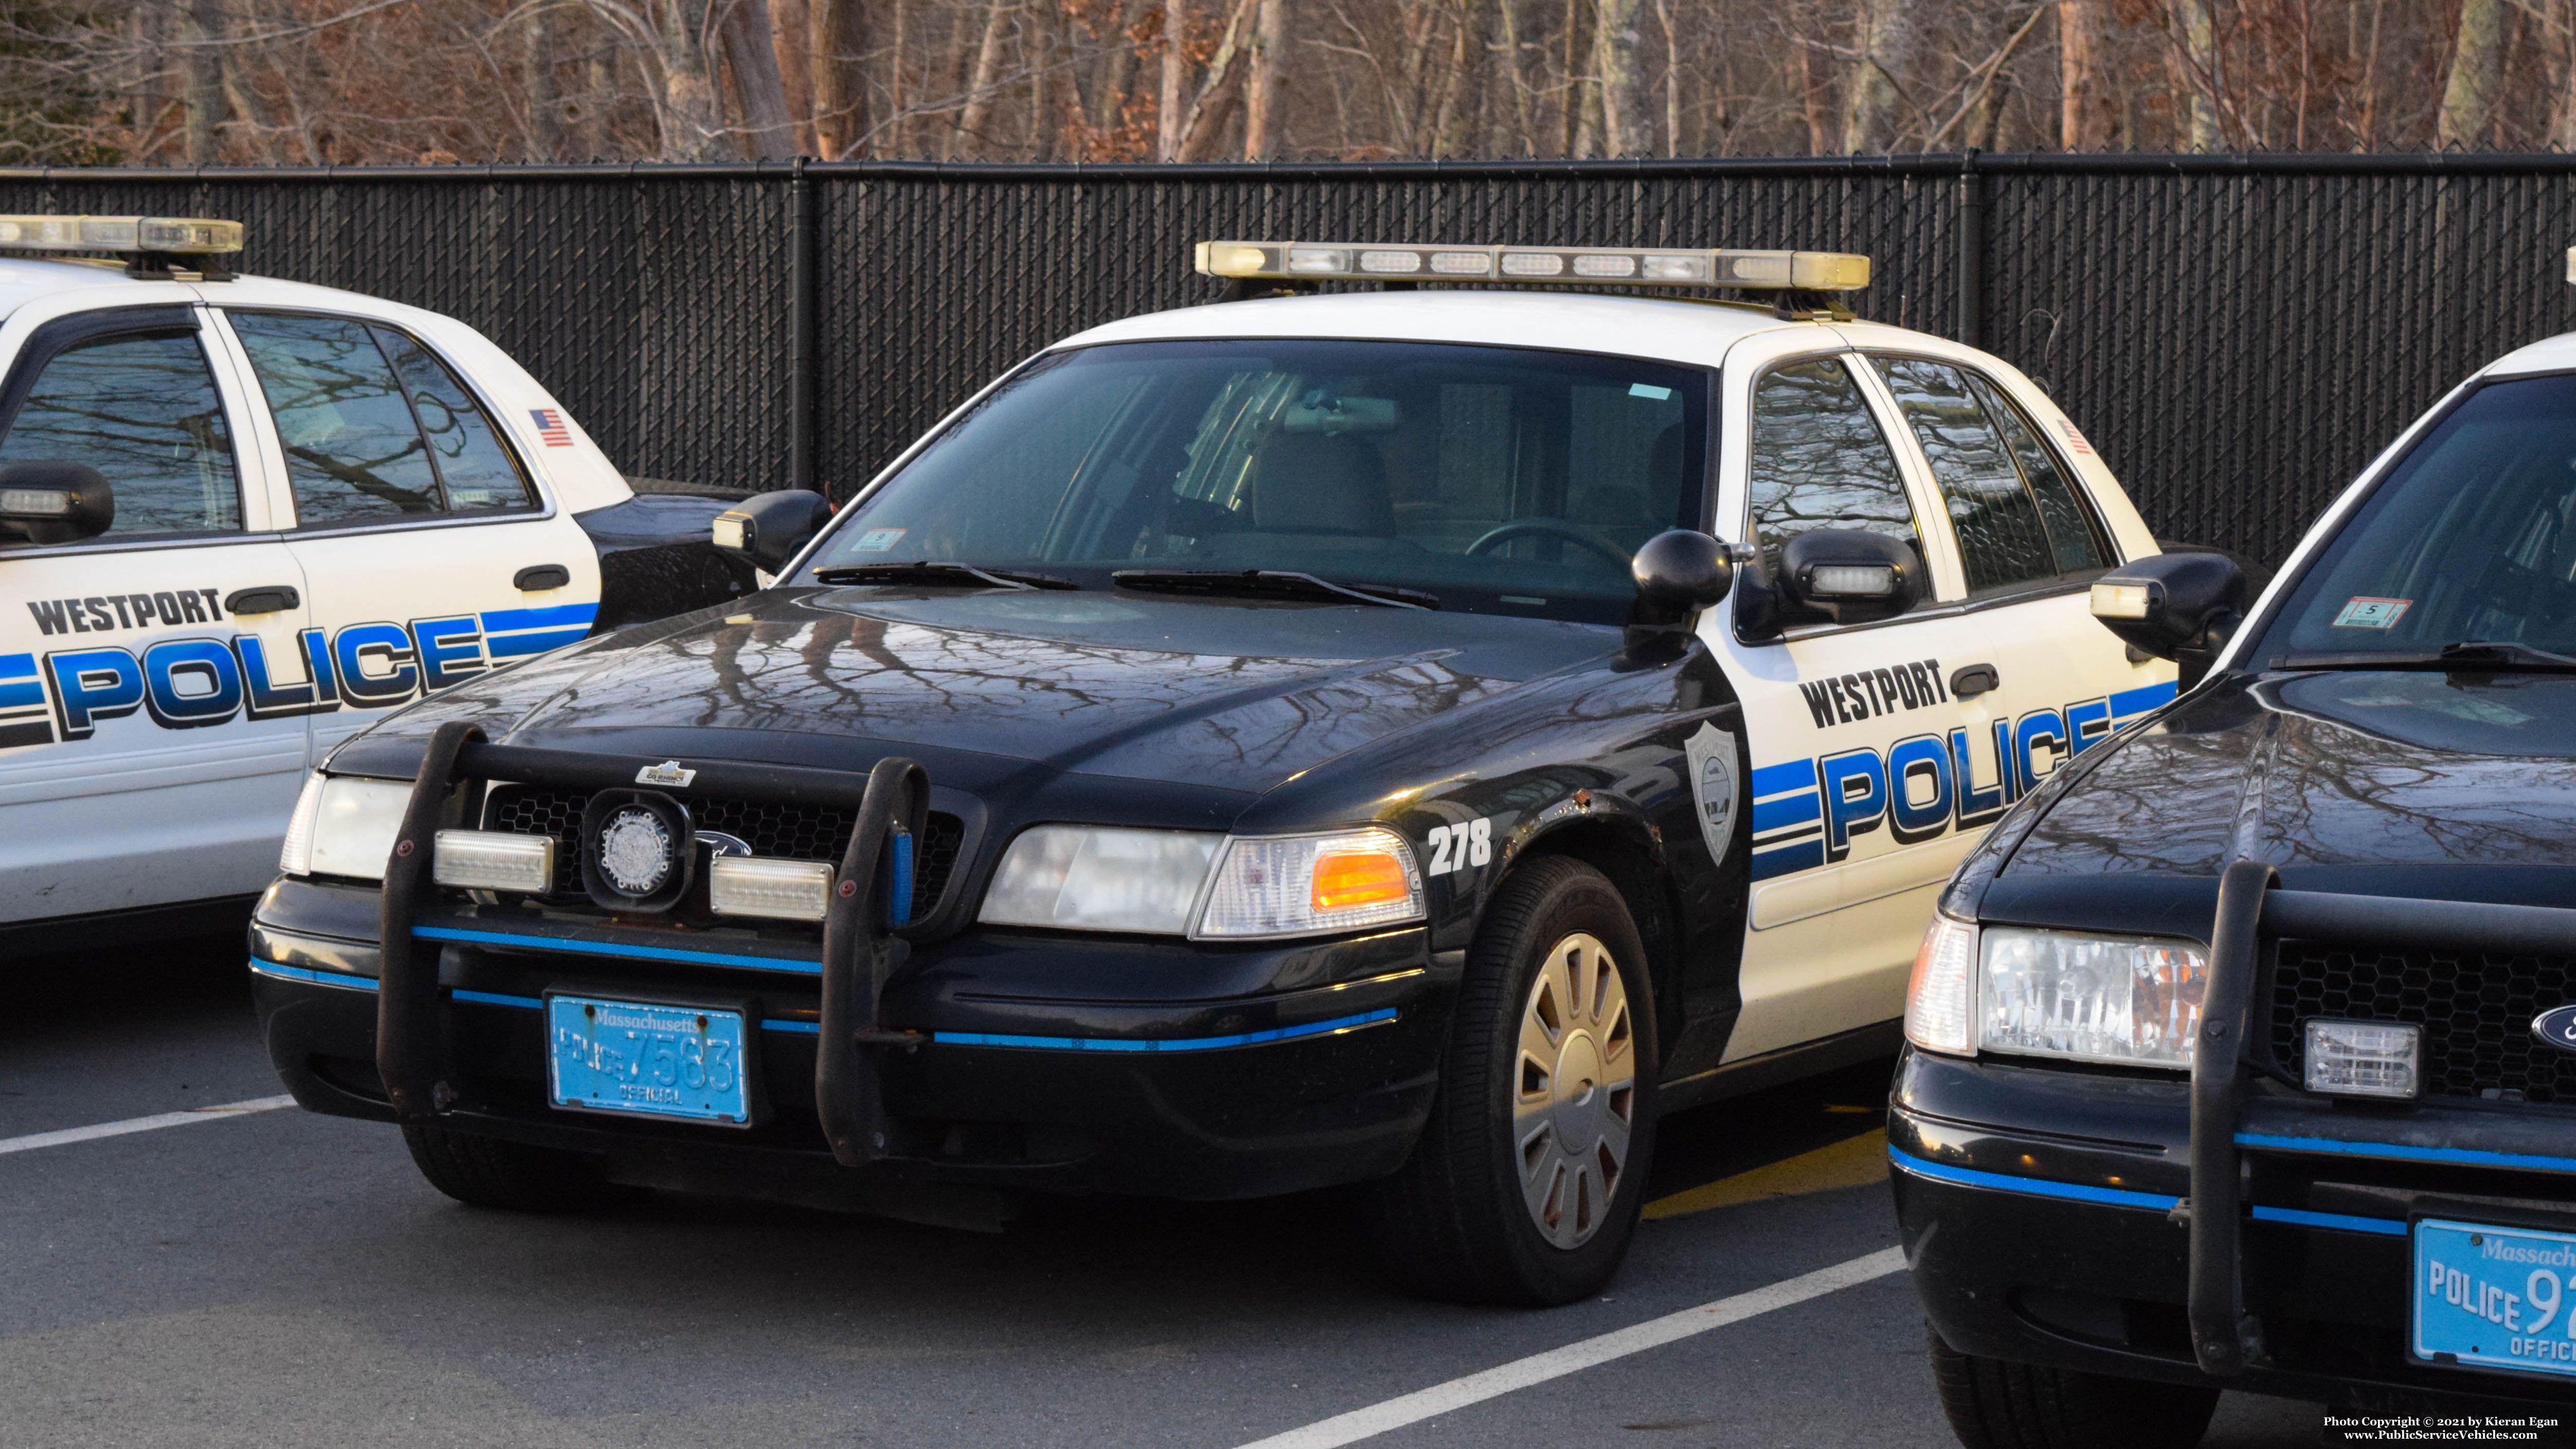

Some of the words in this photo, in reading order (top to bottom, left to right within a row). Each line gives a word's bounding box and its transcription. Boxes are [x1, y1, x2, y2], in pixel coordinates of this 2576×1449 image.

[26, 588, 223, 635] WESTPORT
[2366, 605, 2378, 614] 5
[42, 613, 490, 742] POLICE
[1798, 659, 1948, 728] WESTPORT
[1428, 817, 1491, 876] 278
[595, 1008, 699, 1033] Massachusetts
[624, 1031, 734, 1093] 7583
[2429, 1260, 2520, 1332] POLICE
[2527, 1269, 2576, 1341] 9
